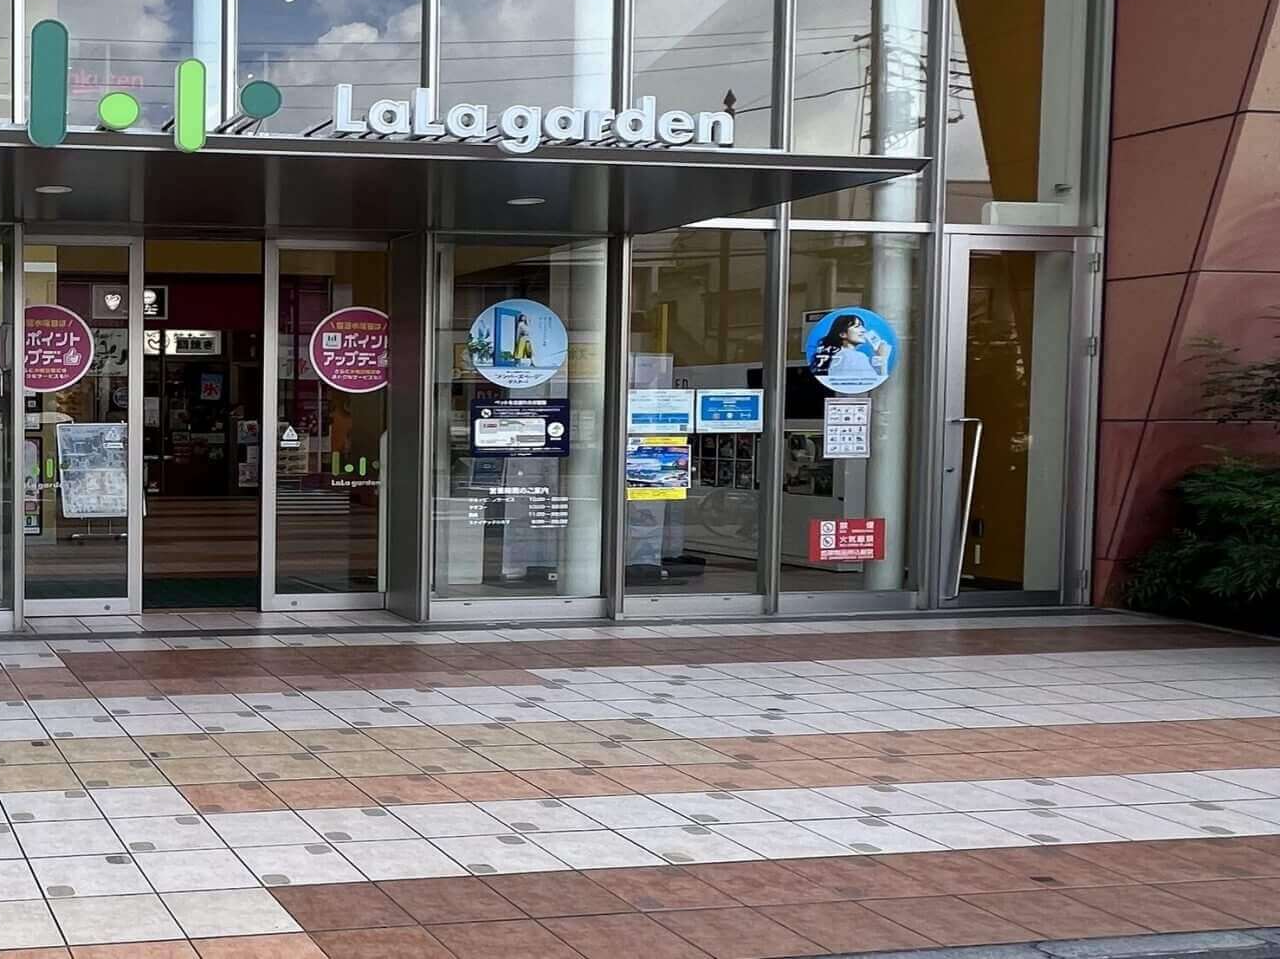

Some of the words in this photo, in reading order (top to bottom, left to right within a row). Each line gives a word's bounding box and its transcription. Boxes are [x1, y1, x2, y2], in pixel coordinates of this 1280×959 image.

[333, 83, 488, 140] LaLa
[498, 95, 734, 153] garden
[26, 329, 81, 347] ポイント
[323, 350, 377, 367] アップデー
